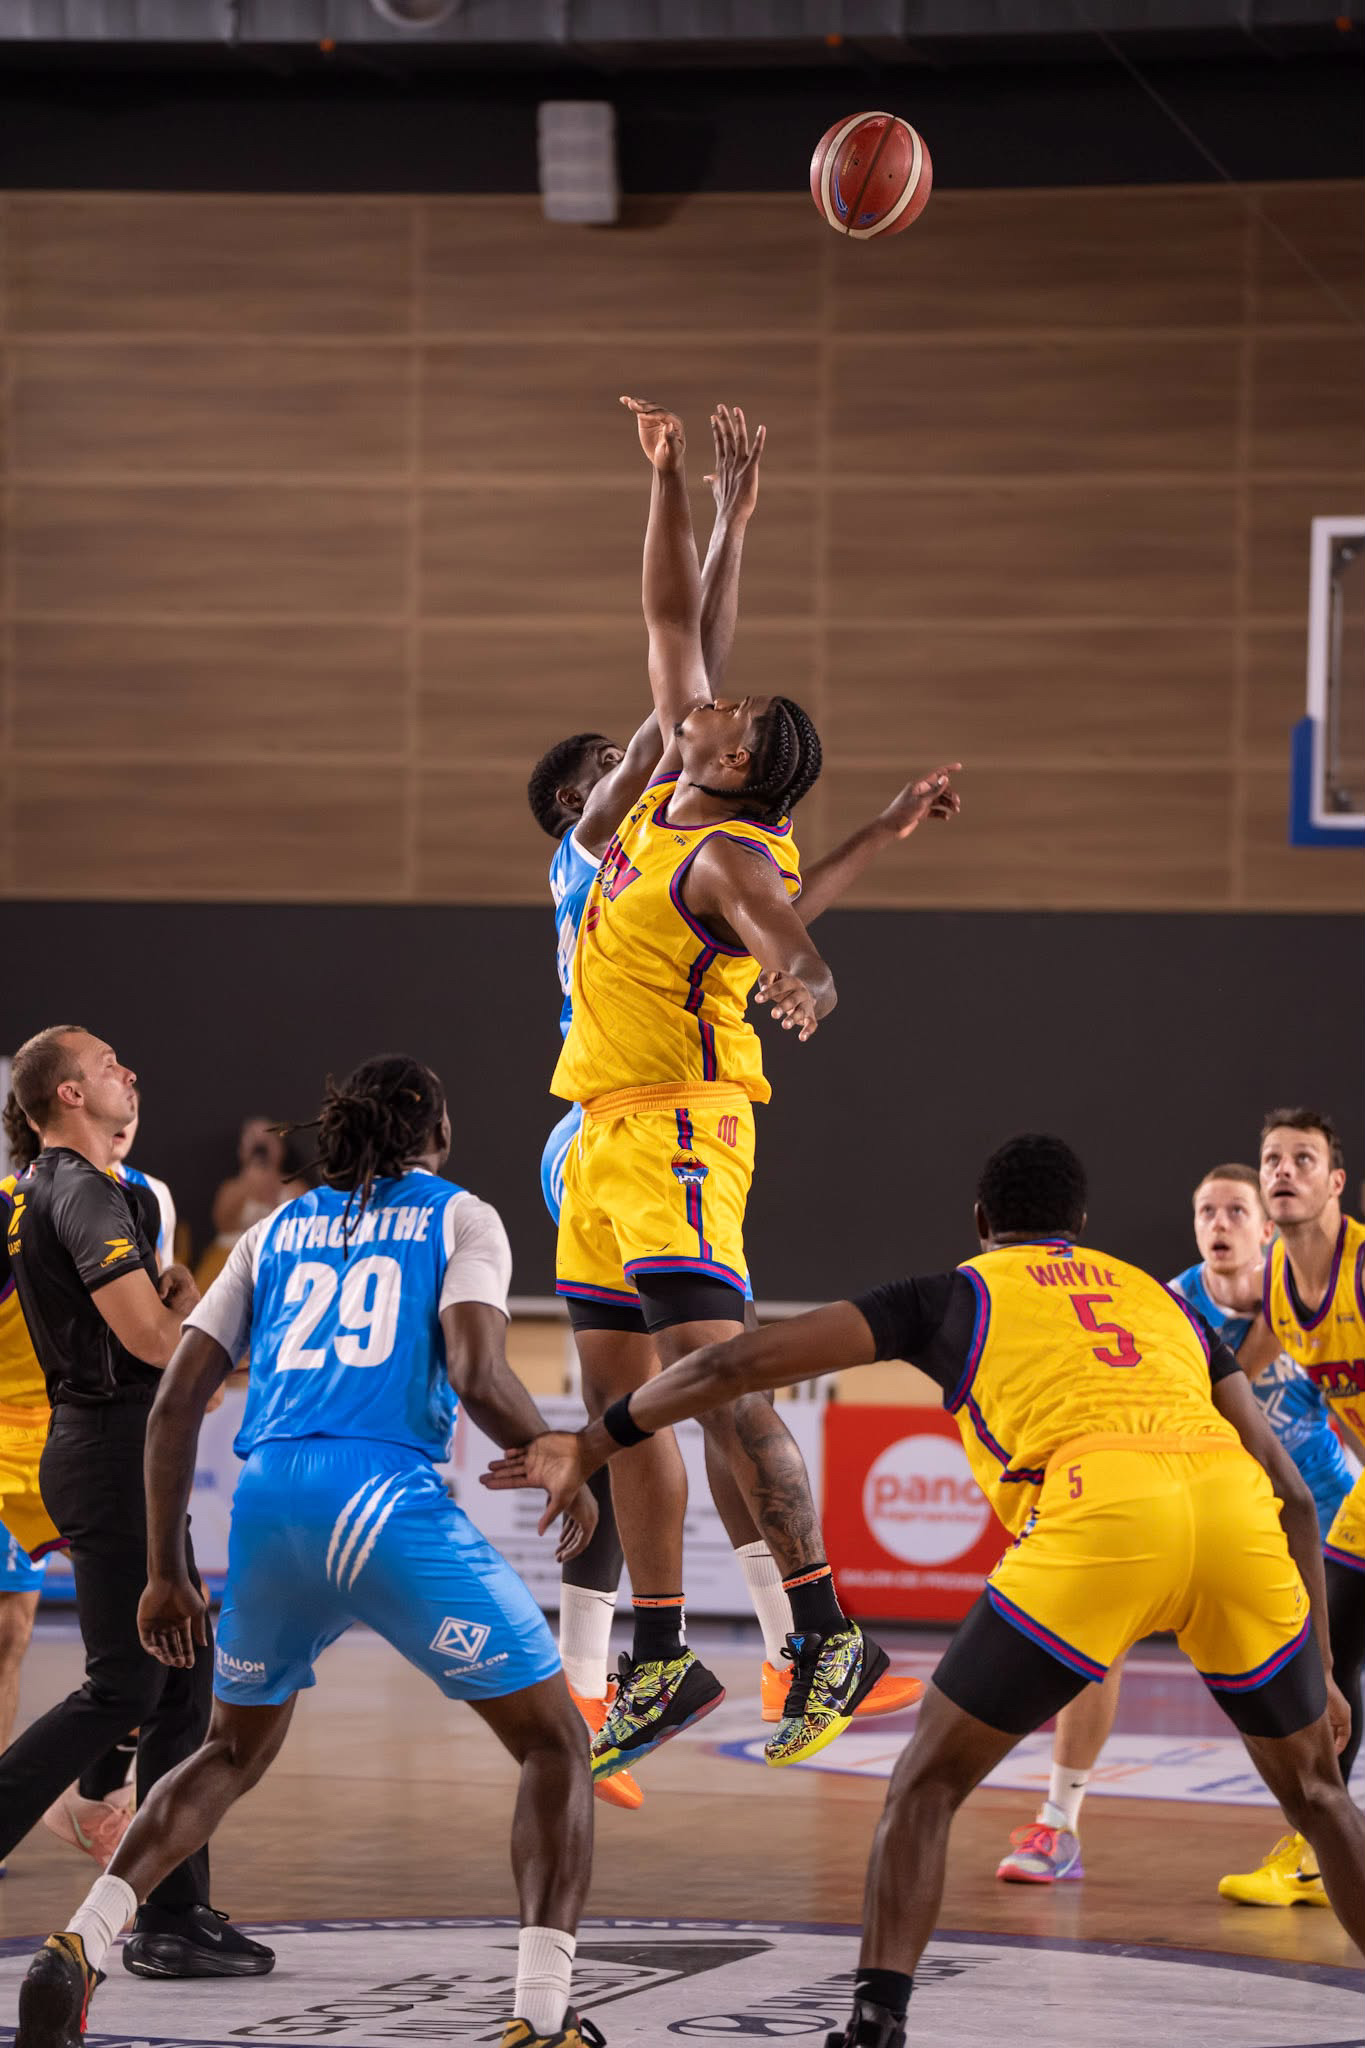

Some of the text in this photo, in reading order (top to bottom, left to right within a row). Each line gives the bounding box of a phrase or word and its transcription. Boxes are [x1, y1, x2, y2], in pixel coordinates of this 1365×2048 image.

[275, 1206, 435, 1253] HYACINTHE
[275, 1254, 402, 1373] 29
[1069, 1293, 1142, 1368] 5
[1068, 1464, 1083, 1499] 5
[223, 1652, 265, 1673] SALON
[228, 1973, 513, 2037] GROUPE
